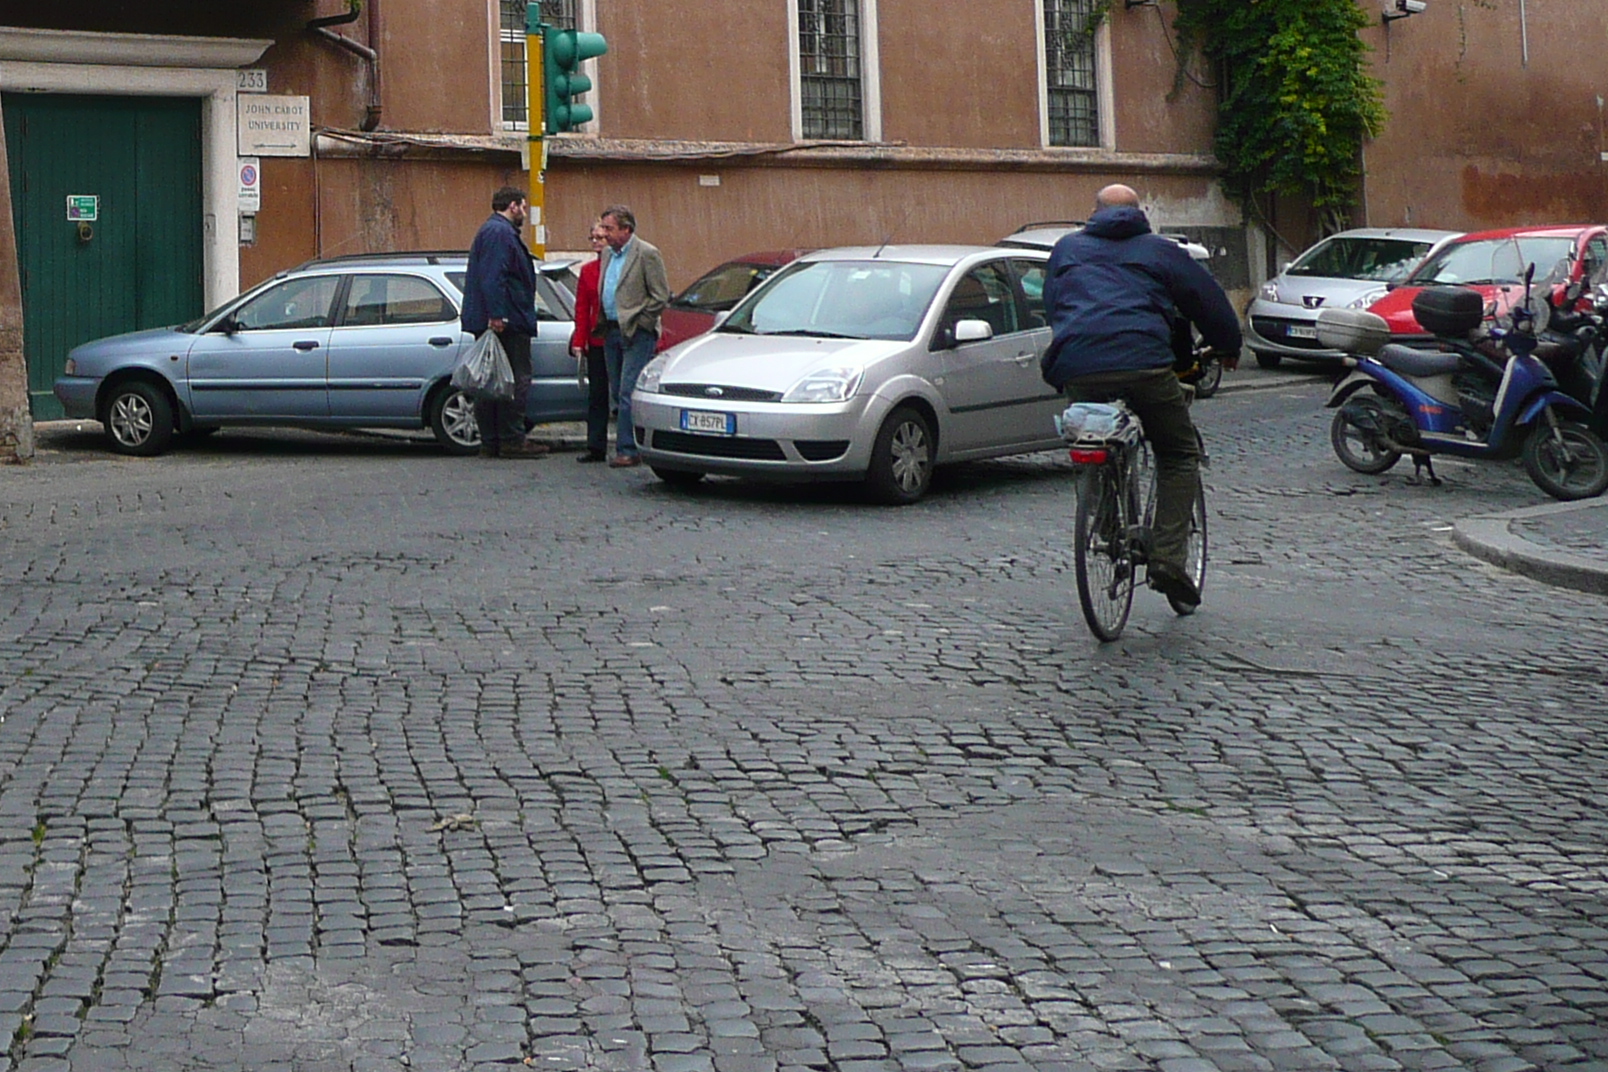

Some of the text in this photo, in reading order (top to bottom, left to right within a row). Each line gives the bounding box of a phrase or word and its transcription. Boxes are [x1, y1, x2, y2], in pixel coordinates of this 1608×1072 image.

[238, 72, 264, 89] 233
[245, 104, 304, 116] JOHN CABOT
[248, 120, 302, 132] UNIVERSITY
